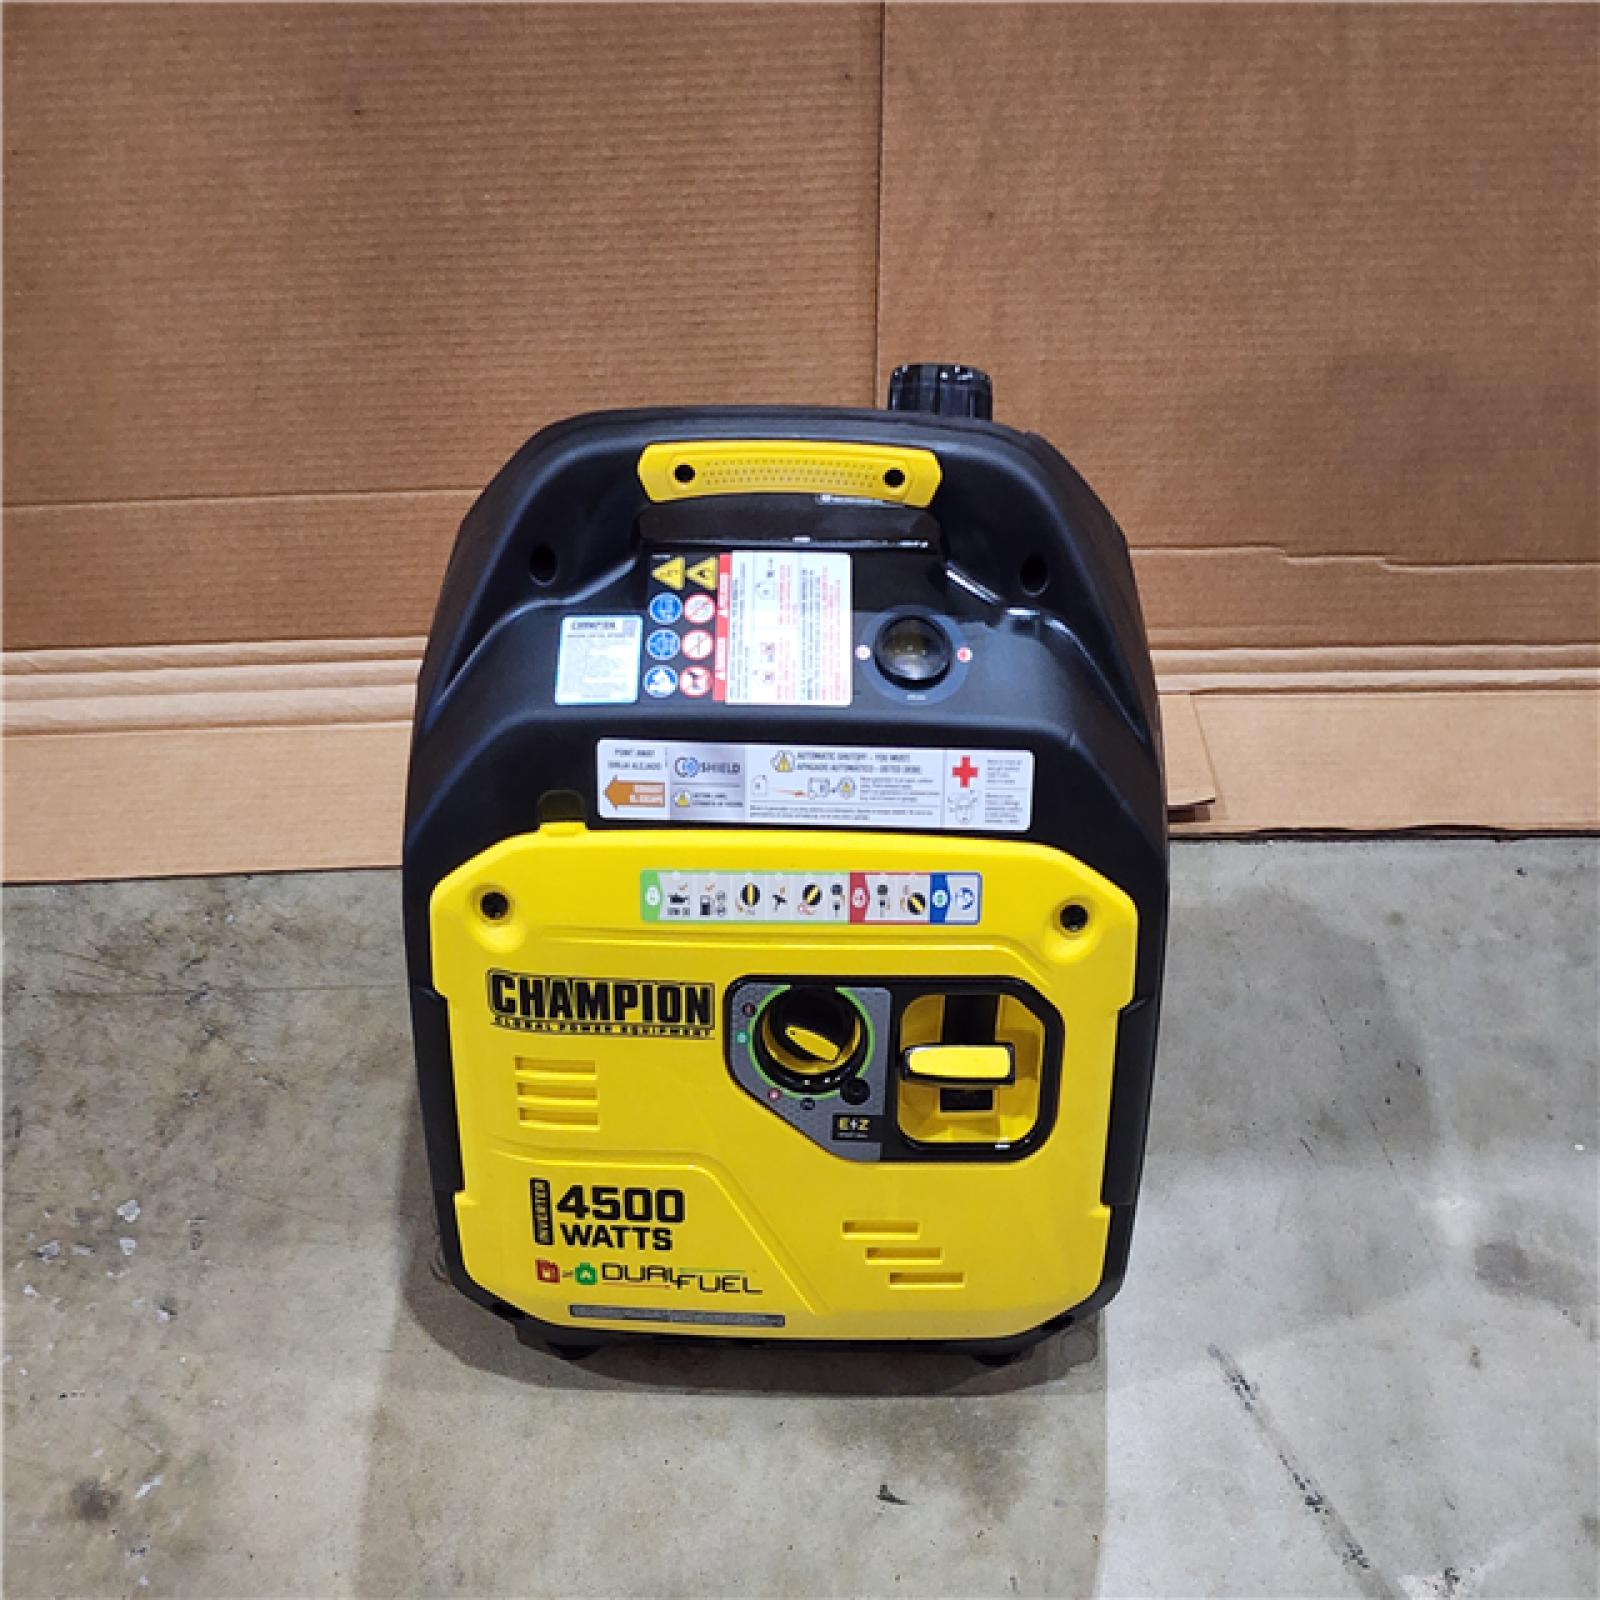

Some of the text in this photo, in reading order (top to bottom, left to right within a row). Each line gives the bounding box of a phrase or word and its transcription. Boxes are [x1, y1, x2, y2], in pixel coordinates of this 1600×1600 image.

[701, 761, 741, 775] SHIELD
[489, 971, 714, 1026] CHAMPION
[494, 1015, 712, 1038] GLOBAL POWER EQUIPMENT
[556, 1184, 685, 1223] 4500
[560, 1223, 673, 1251] WATTS
